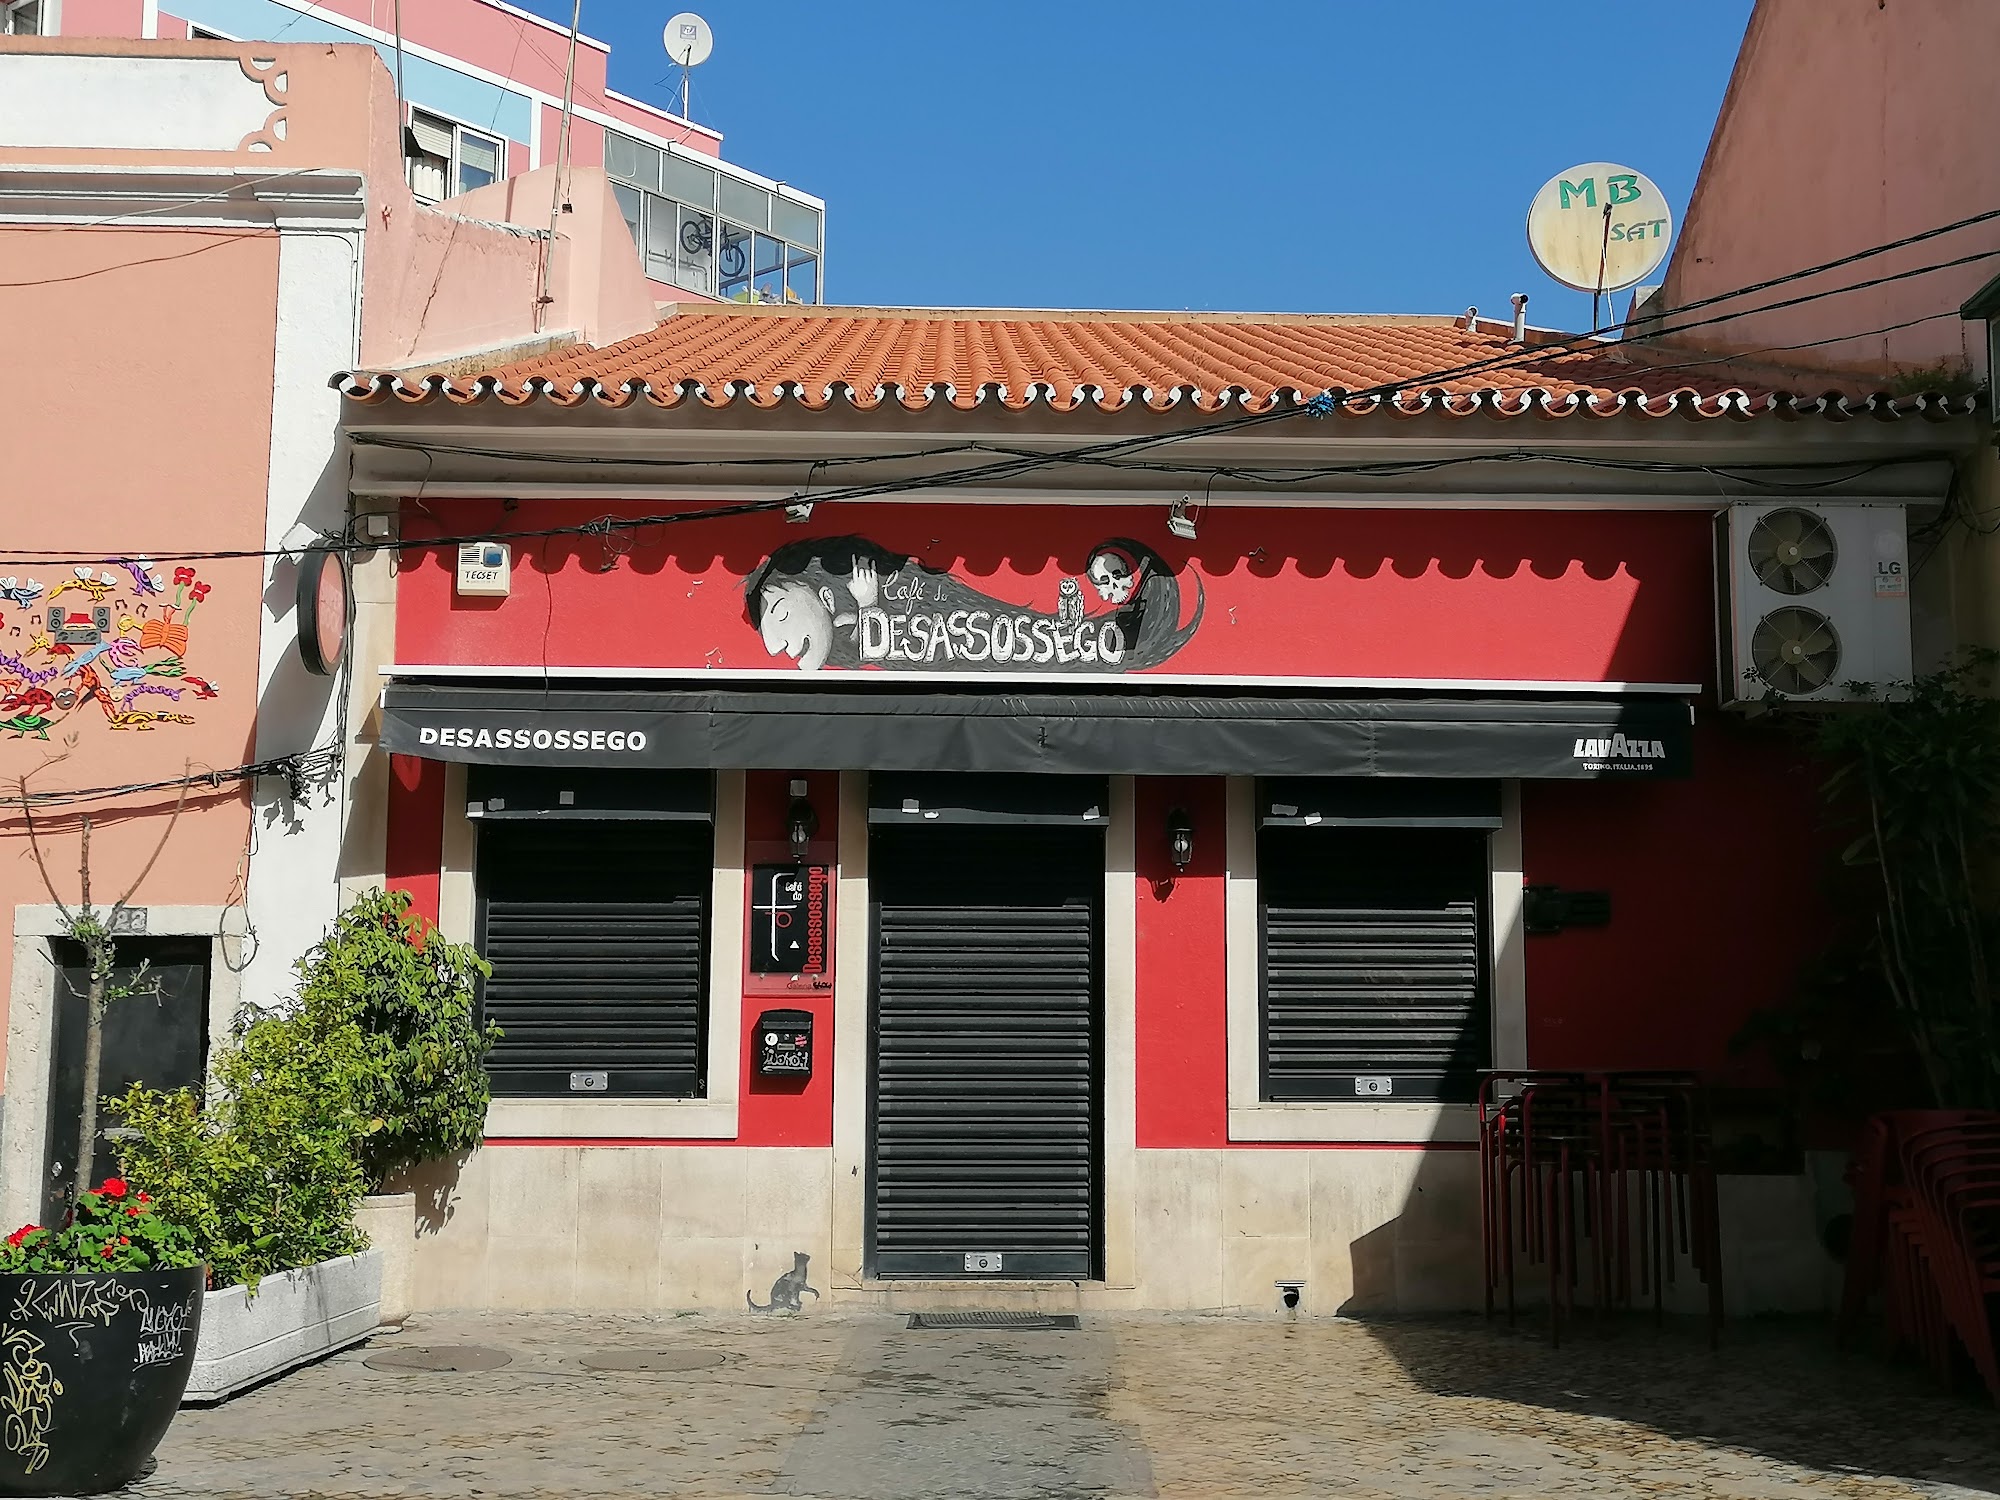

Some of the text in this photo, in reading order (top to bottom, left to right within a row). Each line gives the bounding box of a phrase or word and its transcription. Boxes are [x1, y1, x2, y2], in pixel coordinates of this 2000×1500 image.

[1610, 218, 1667, 242] SAT
[465, 571, 498, 579] TECSET
[1878, 562, 1901, 575] LG
[881, 569, 949, 616] Café do
[859, 607, 1126, 664] DESASSOSSEGO
[419, 727, 647, 751] DESASSOSSEGO
[803, 866, 828, 973] Desassossego
